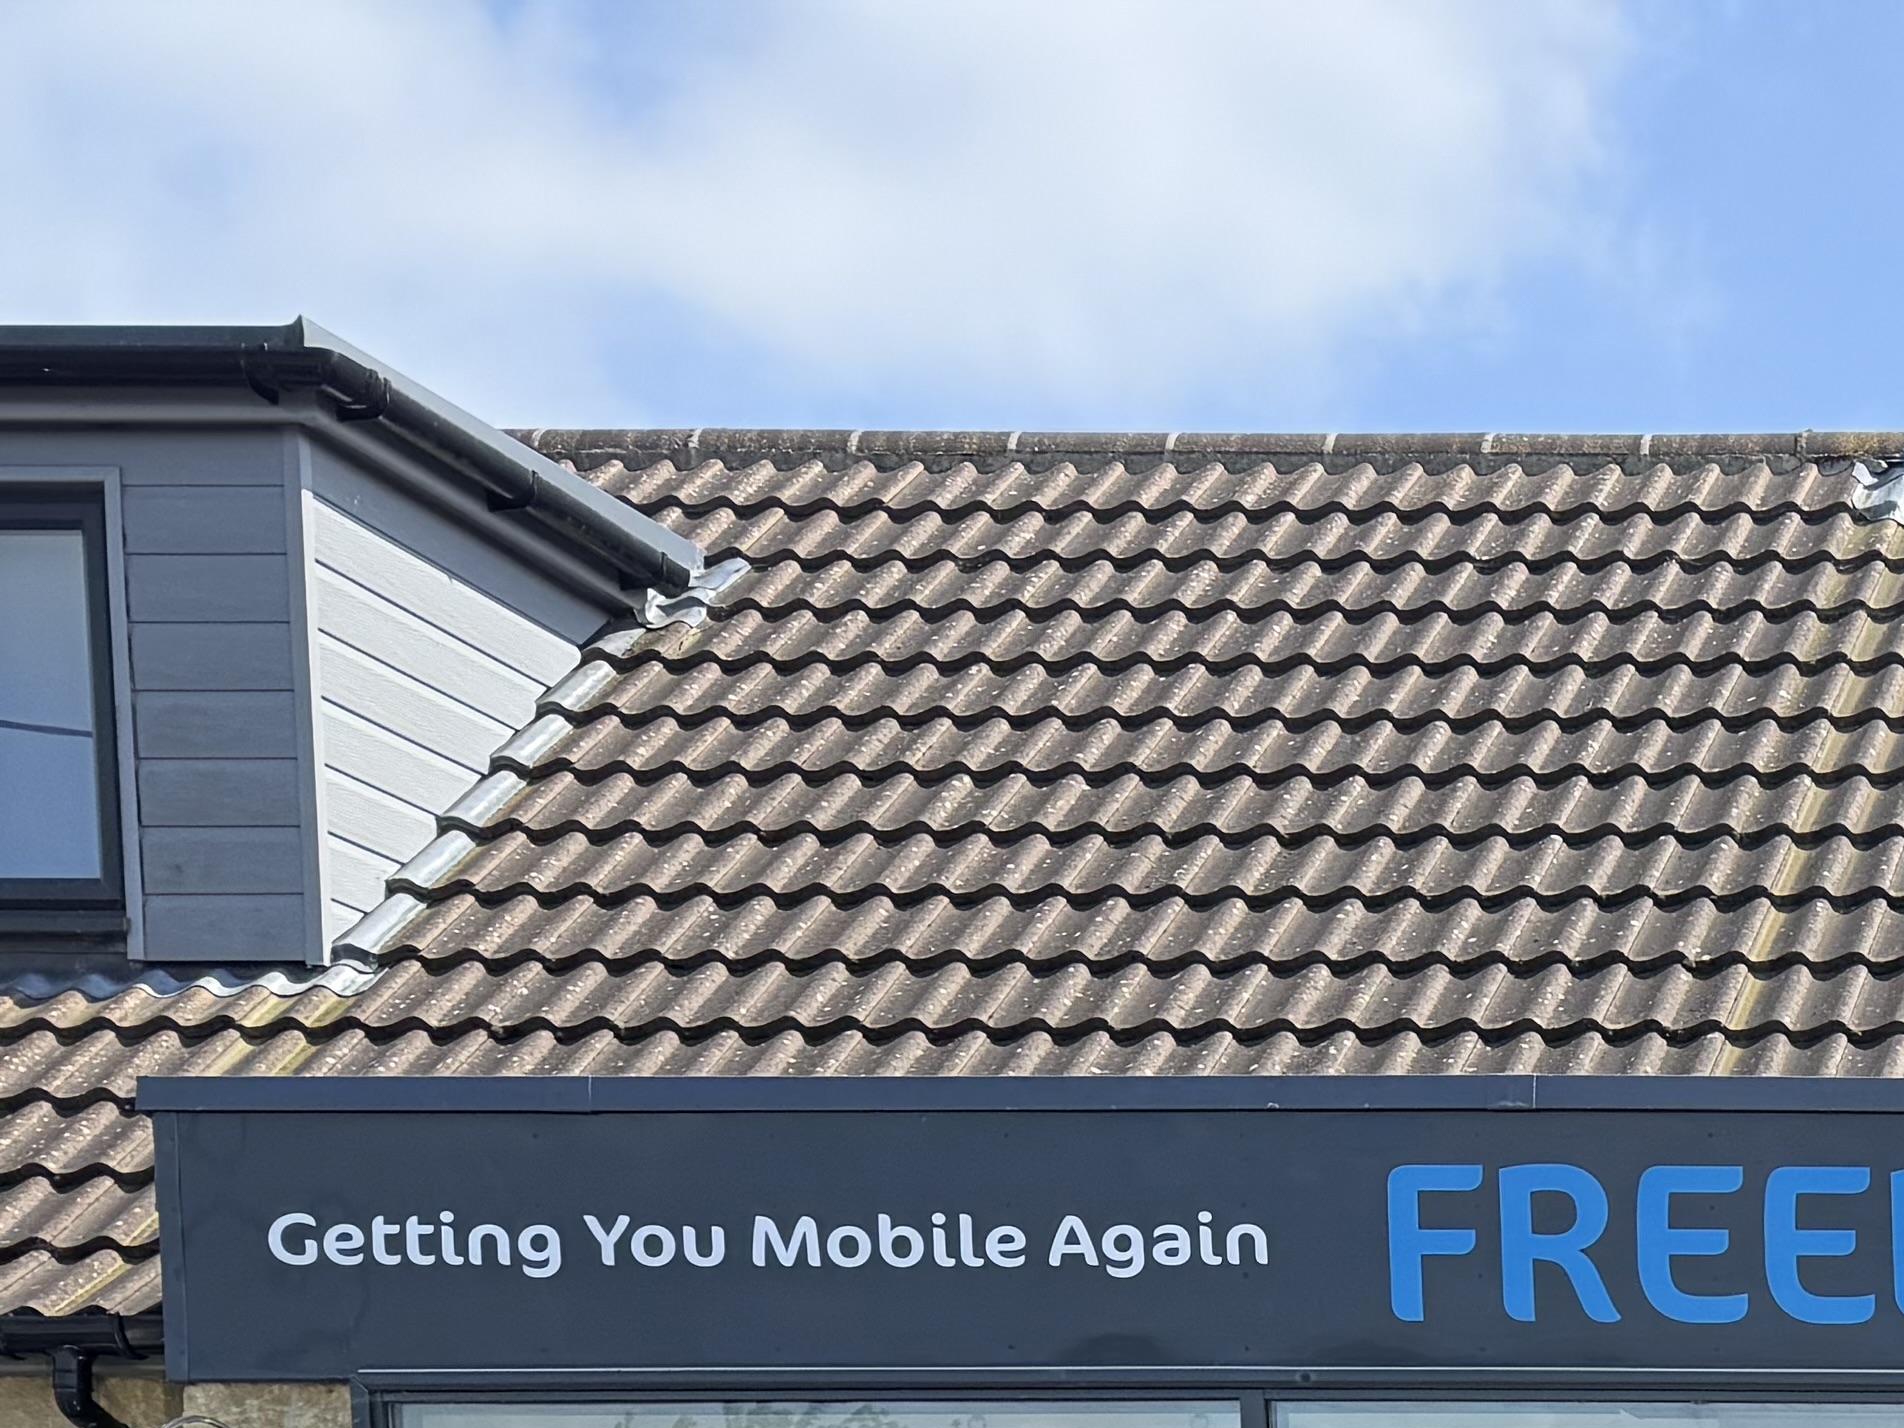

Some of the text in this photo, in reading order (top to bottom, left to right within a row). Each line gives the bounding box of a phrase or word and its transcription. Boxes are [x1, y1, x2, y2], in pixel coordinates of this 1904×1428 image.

[267, 1210, 1269, 1279] Getting You Mobile Again
